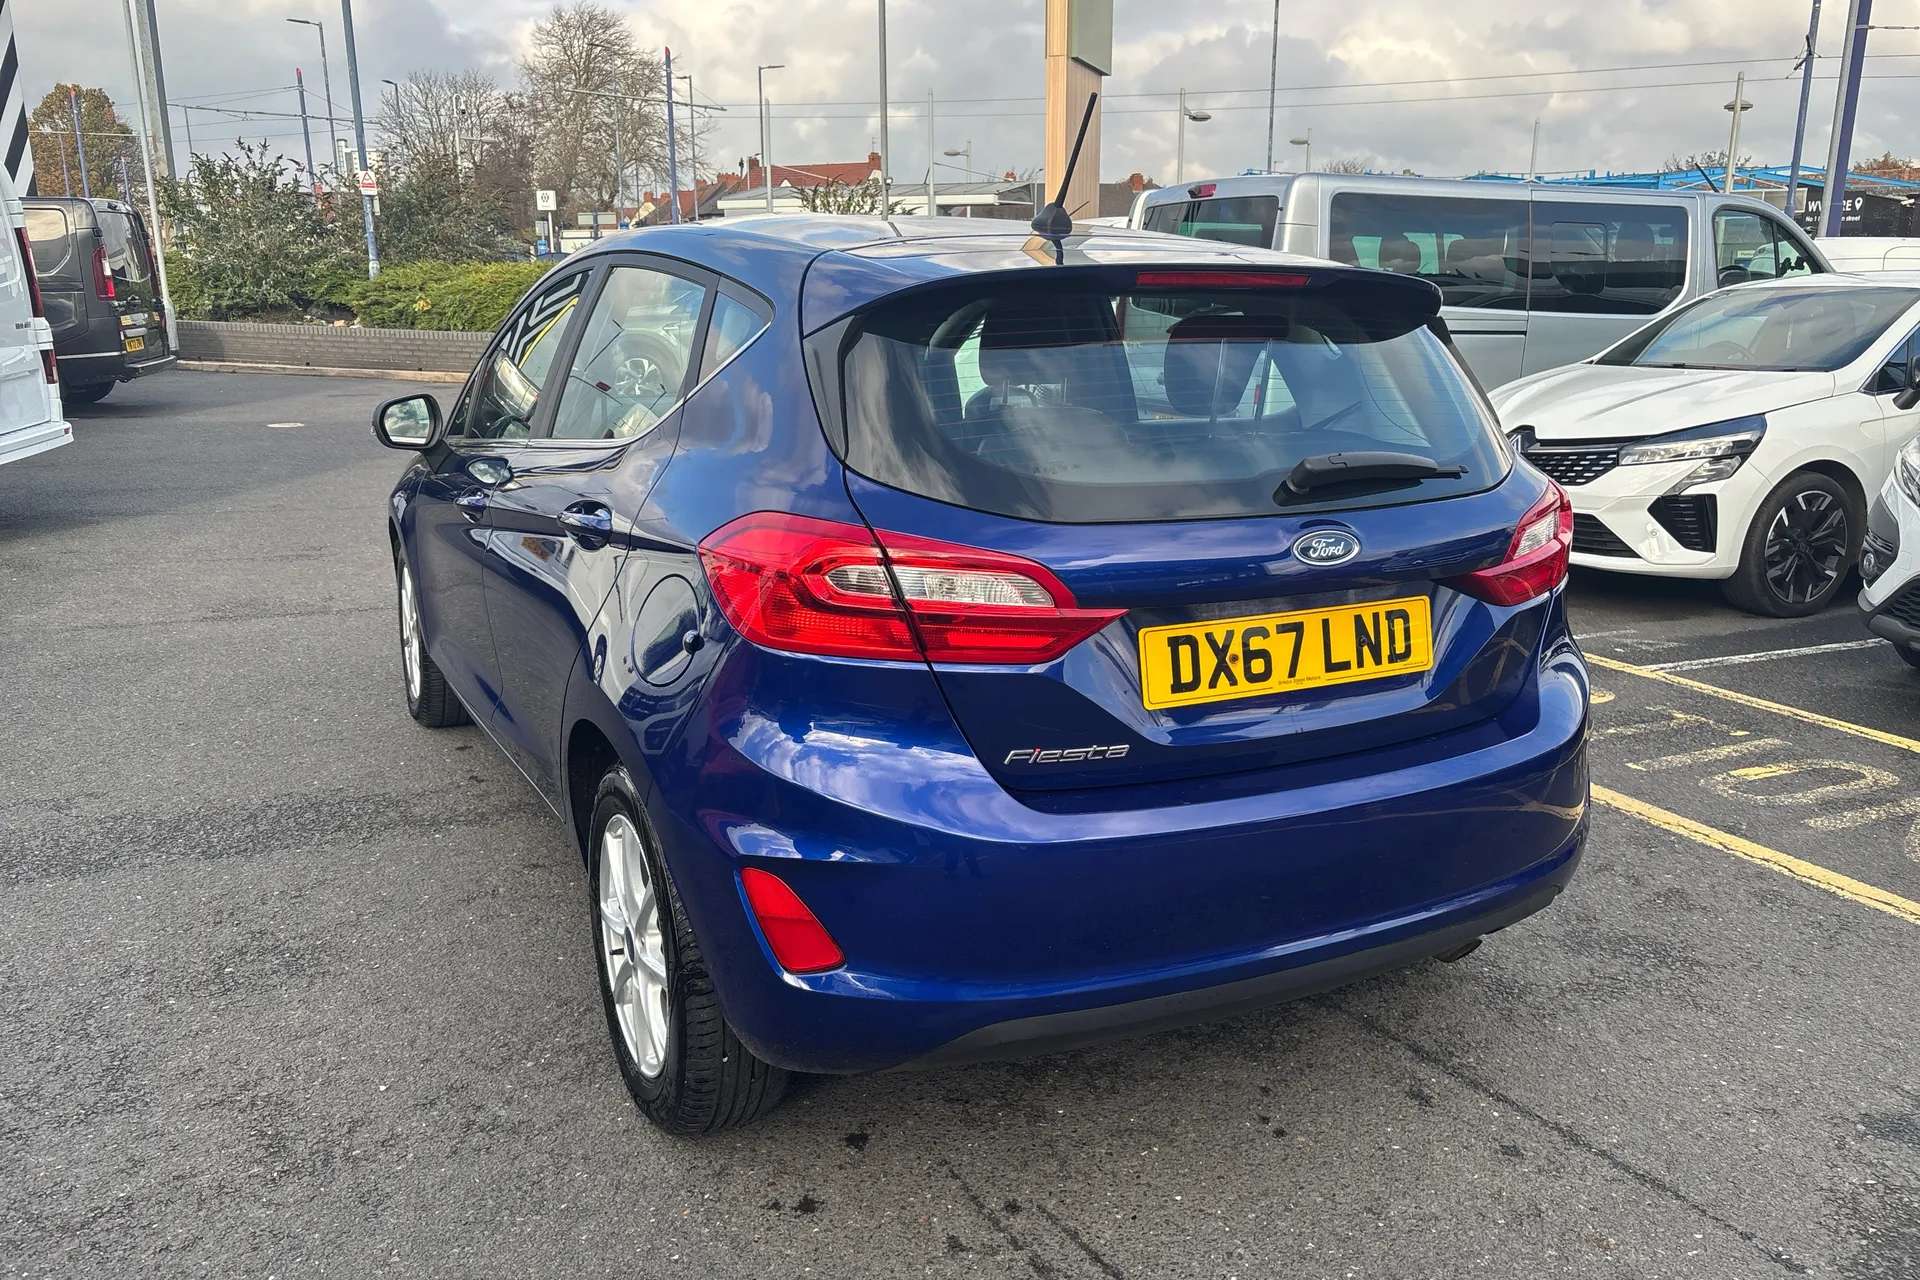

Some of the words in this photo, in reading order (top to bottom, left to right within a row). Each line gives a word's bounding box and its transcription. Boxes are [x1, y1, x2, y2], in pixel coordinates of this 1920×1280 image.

[1310, 538, 1345, 557] Ford
[1167, 621, 1305, 694] DX67
[1321, 608, 1412, 673] LND
[1004, 745, 1129, 765] Fiesta
